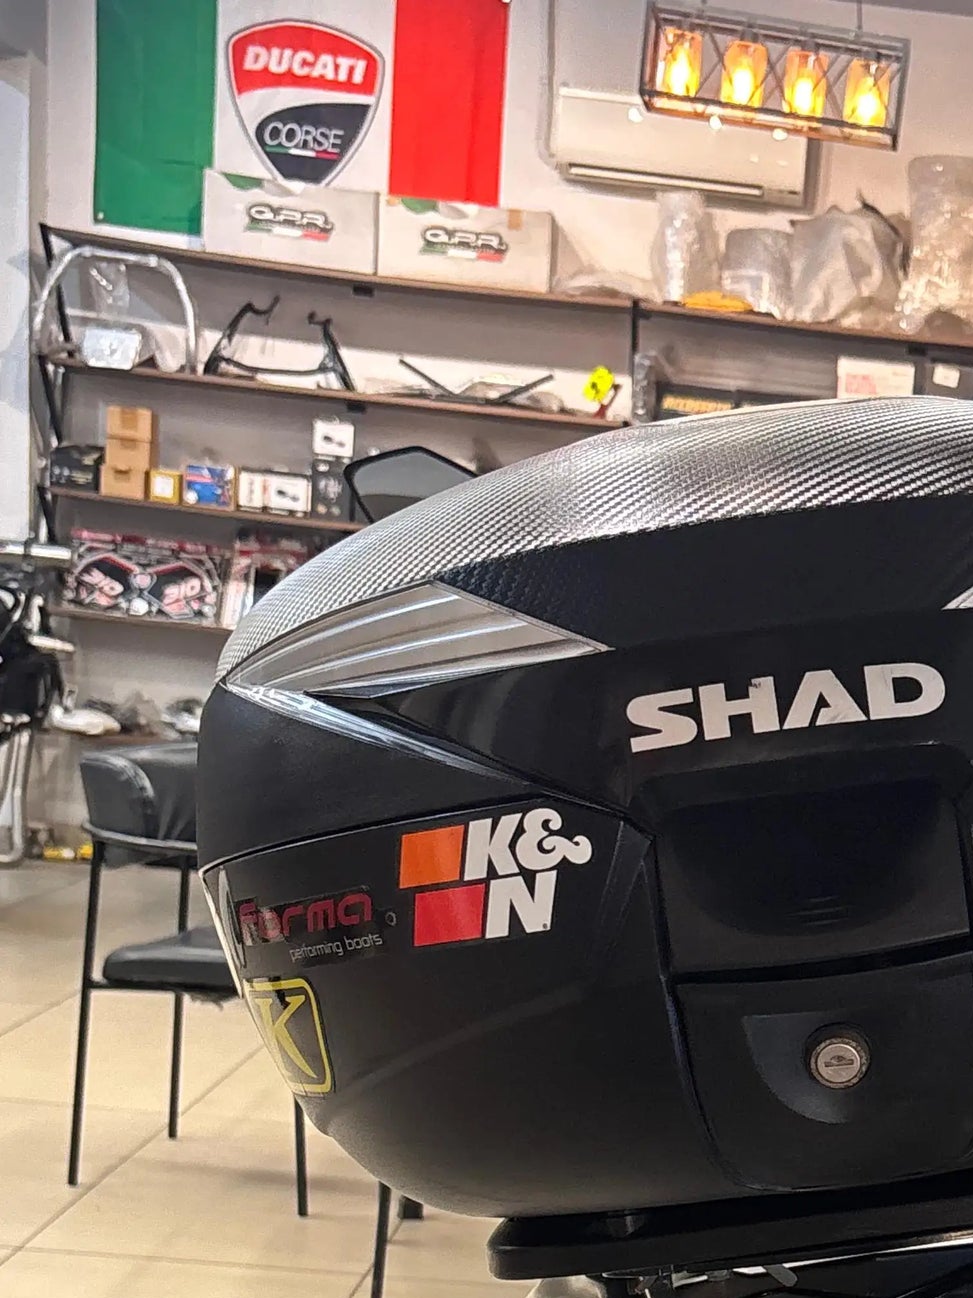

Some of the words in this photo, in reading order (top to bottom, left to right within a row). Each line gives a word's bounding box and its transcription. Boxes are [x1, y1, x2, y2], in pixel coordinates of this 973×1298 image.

[243, 45, 367, 85] DUCATI
[263, 121, 345, 153] CORSE
[626, 662, 946, 753] SHAD
[239, 892, 372, 946] forma
[289, 938, 344, 963] performing
[344, 932, 384, 952] boots
